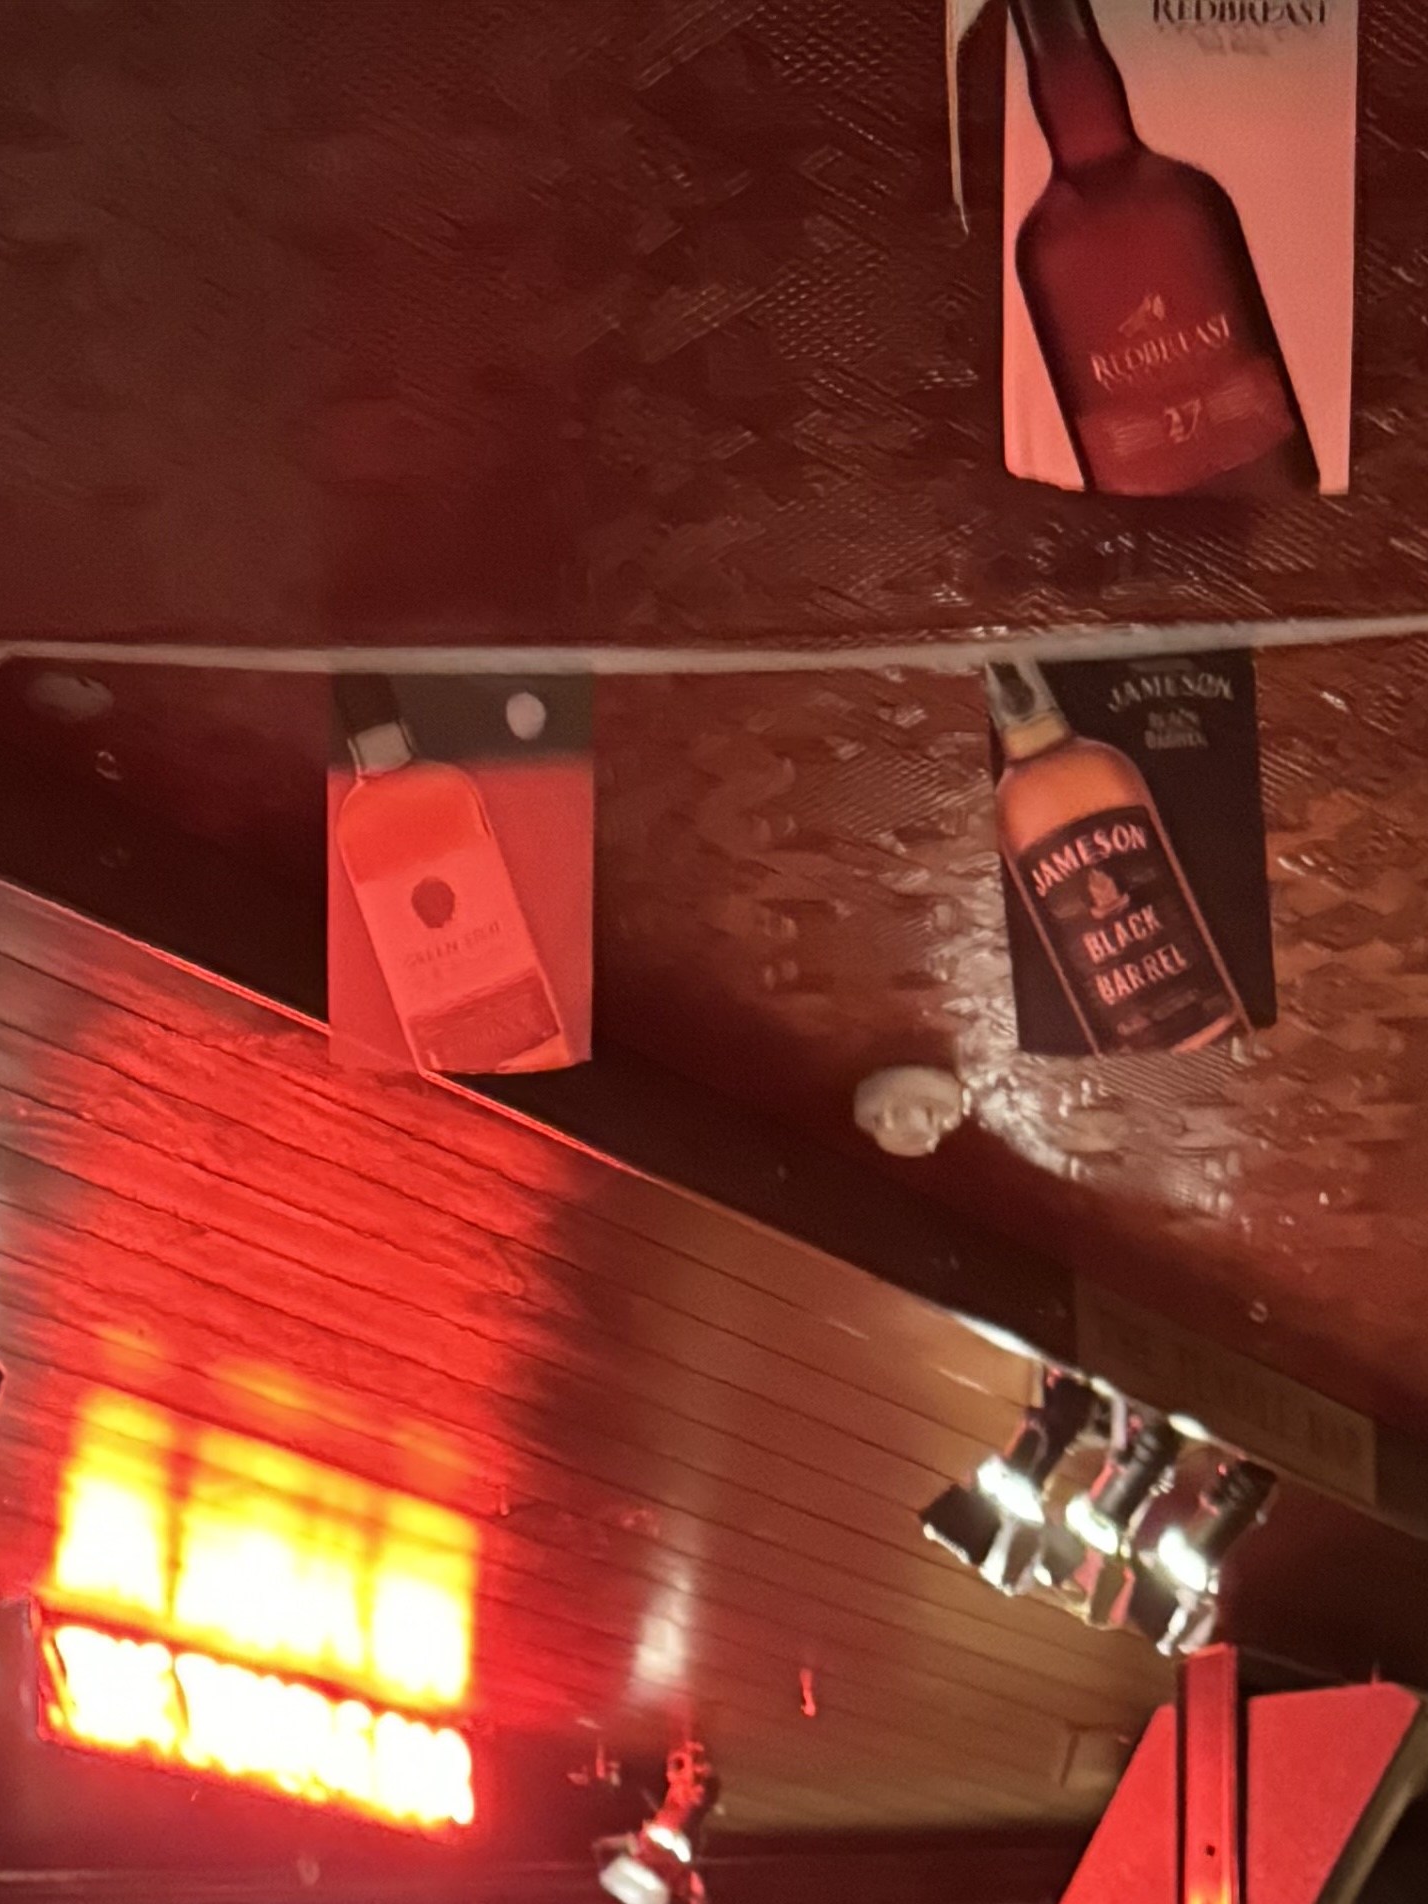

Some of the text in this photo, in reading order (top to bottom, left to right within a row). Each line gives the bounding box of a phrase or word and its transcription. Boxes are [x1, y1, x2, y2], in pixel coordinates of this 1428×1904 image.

[1106, 671, 1235, 713] JAMESON
[1030, 822, 1148, 898] JAMESON
[1082, 904, 1164, 966] BLACK
[1095, 943, 1188, 1006] BARREL
